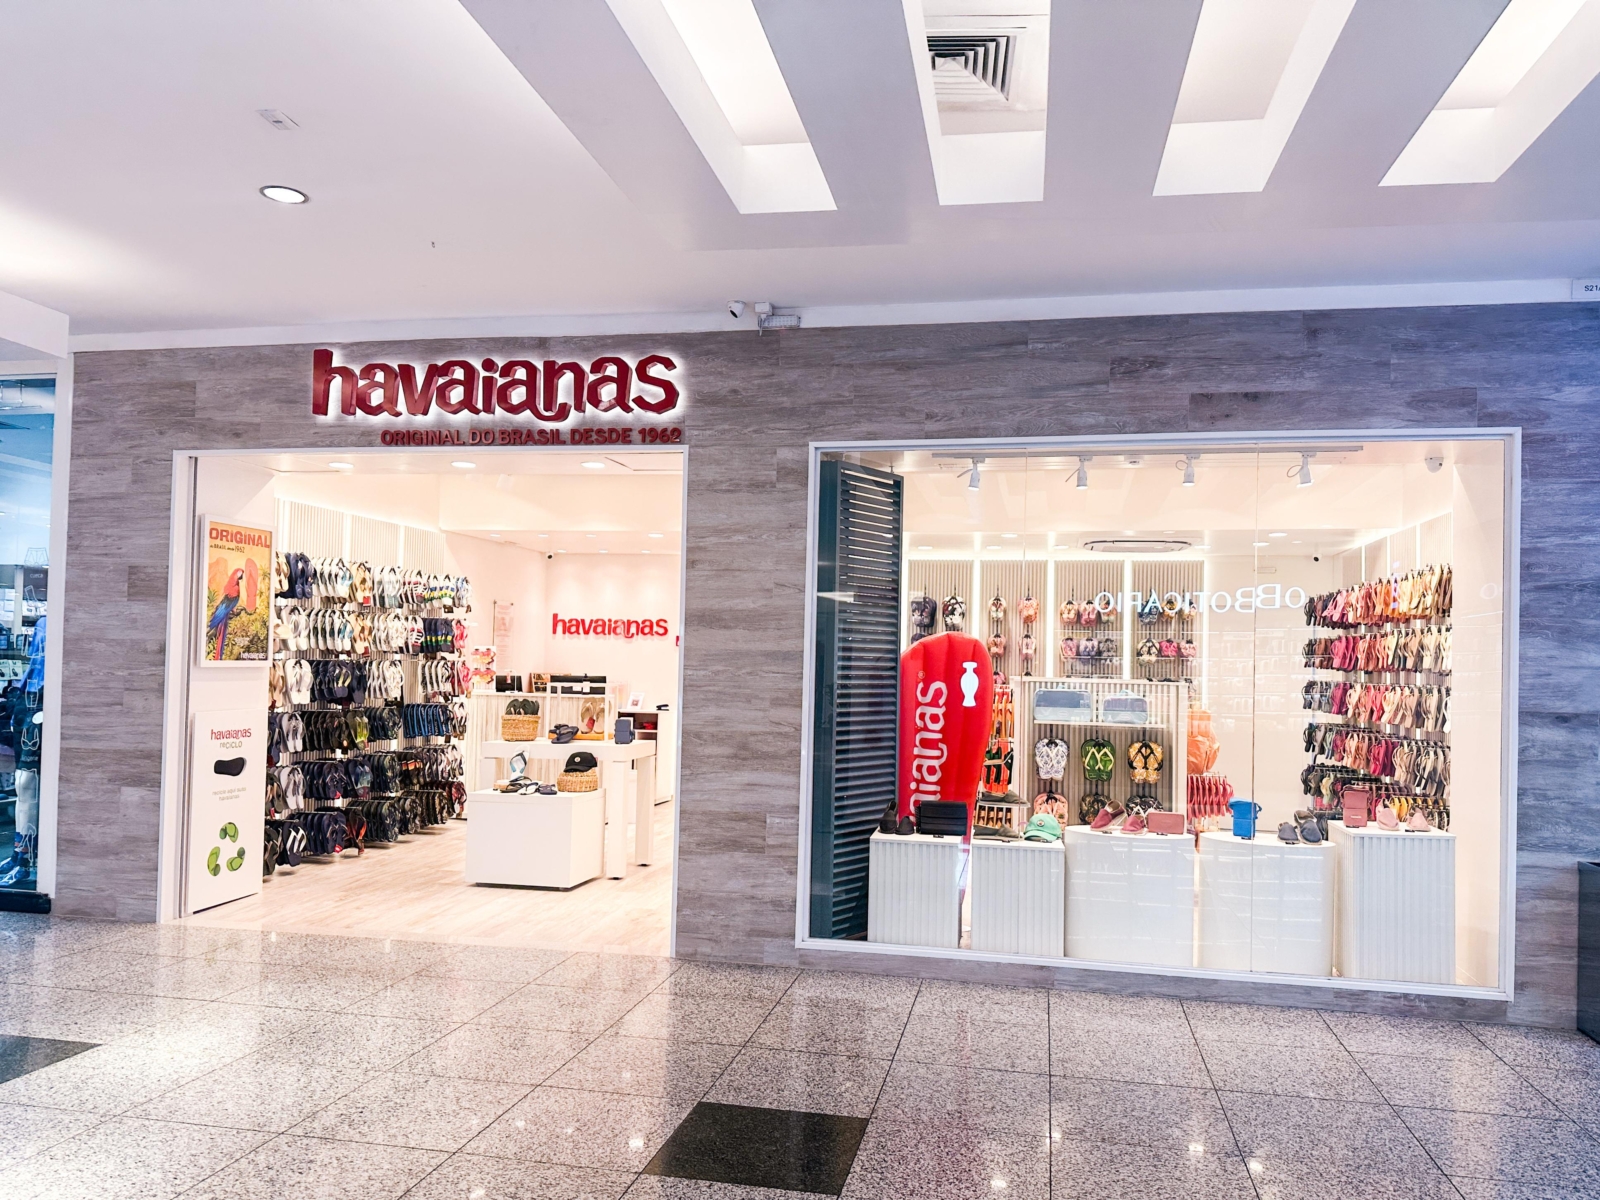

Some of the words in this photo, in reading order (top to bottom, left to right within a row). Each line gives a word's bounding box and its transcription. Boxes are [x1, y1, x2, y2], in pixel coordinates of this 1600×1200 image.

[312, 348, 680, 423] havaianas
[380, 429, 465, 446] ORIGINAL
[468, 429, 495, 445] DO
[499, 428, 566, 445] BRASIL
[569, 428, 632, 443] DESDE
[637, 427, 682, 443] 1962
[209, 527, 270, 548] ORIGINAL
[552, 613, 669, 639] havaianas
[210, 728, 252, 740] havaianas
